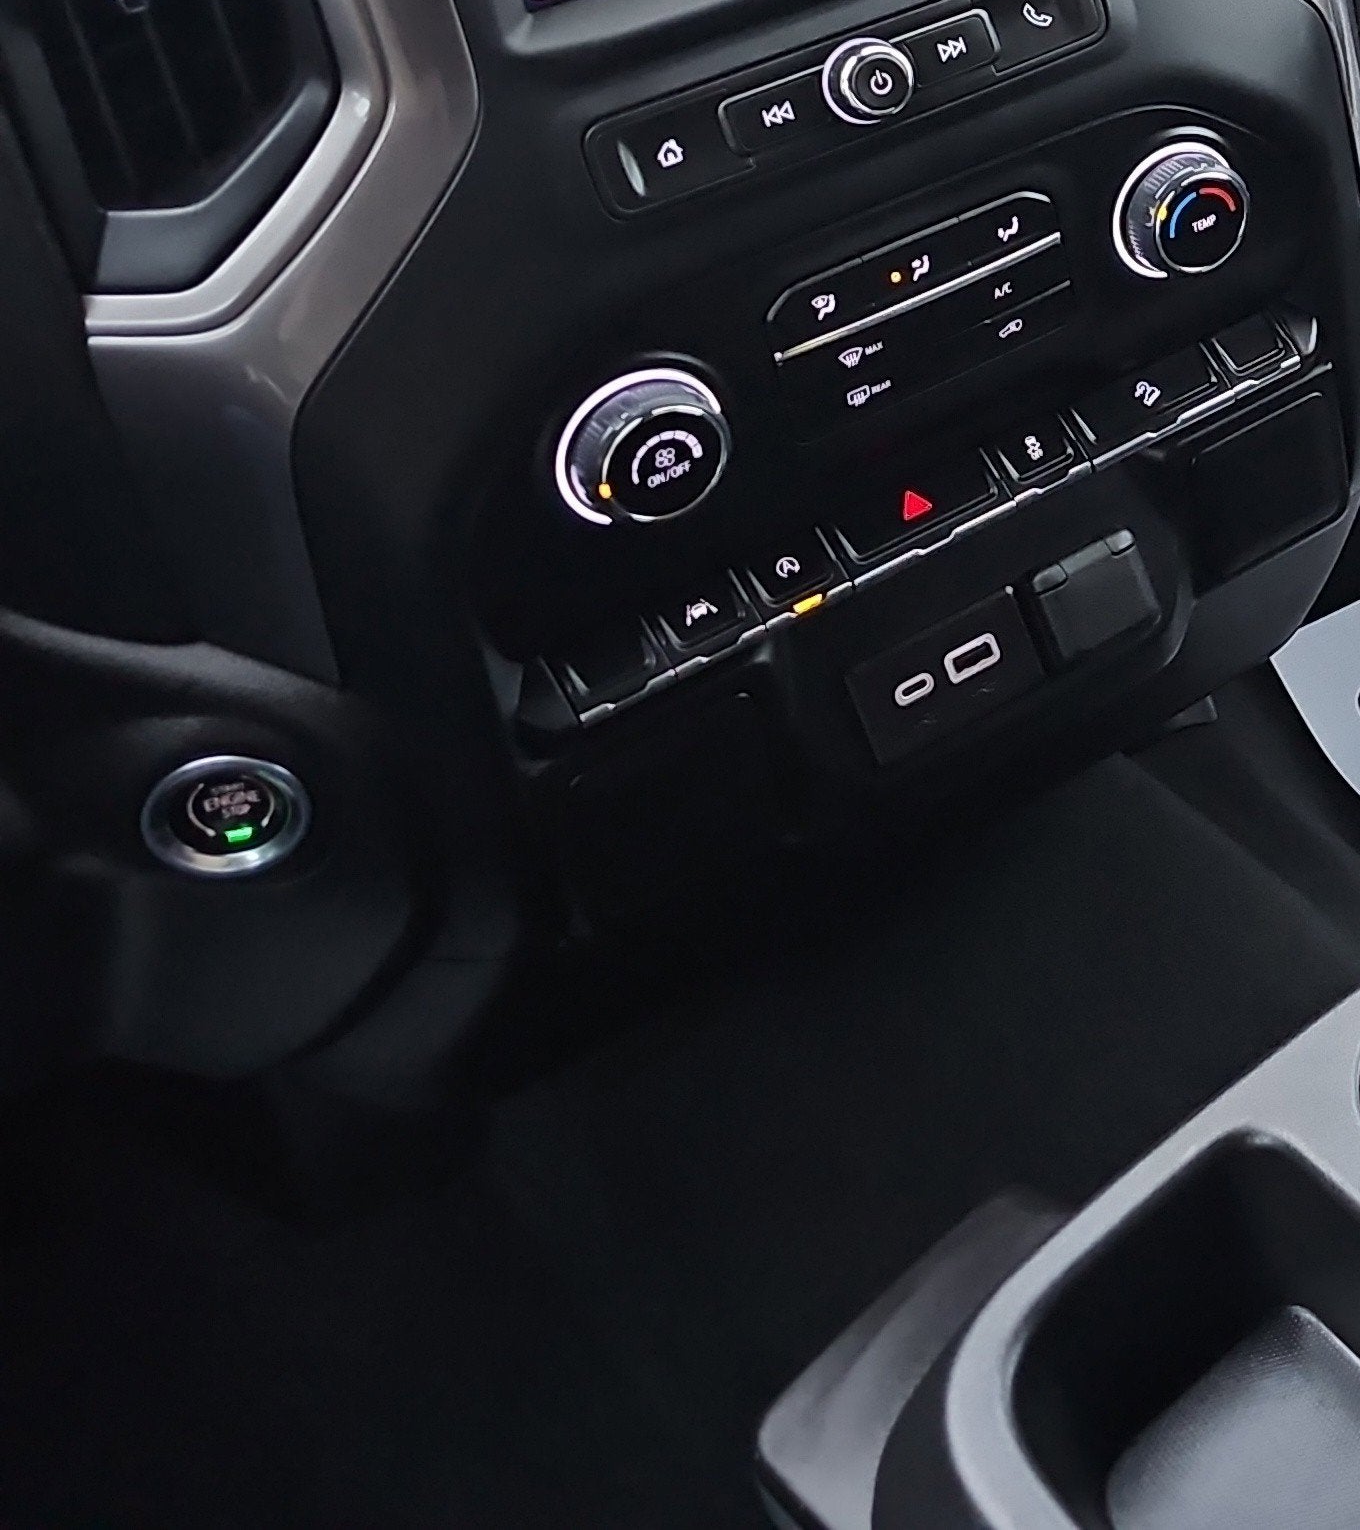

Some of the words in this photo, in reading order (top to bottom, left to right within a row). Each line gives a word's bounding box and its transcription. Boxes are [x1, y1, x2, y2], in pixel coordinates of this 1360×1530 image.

[1192, 214, 1217, 232] TEMP
[864, 341, 884, 355] MAX
[647, 460, 691, 488] ON/OFF
